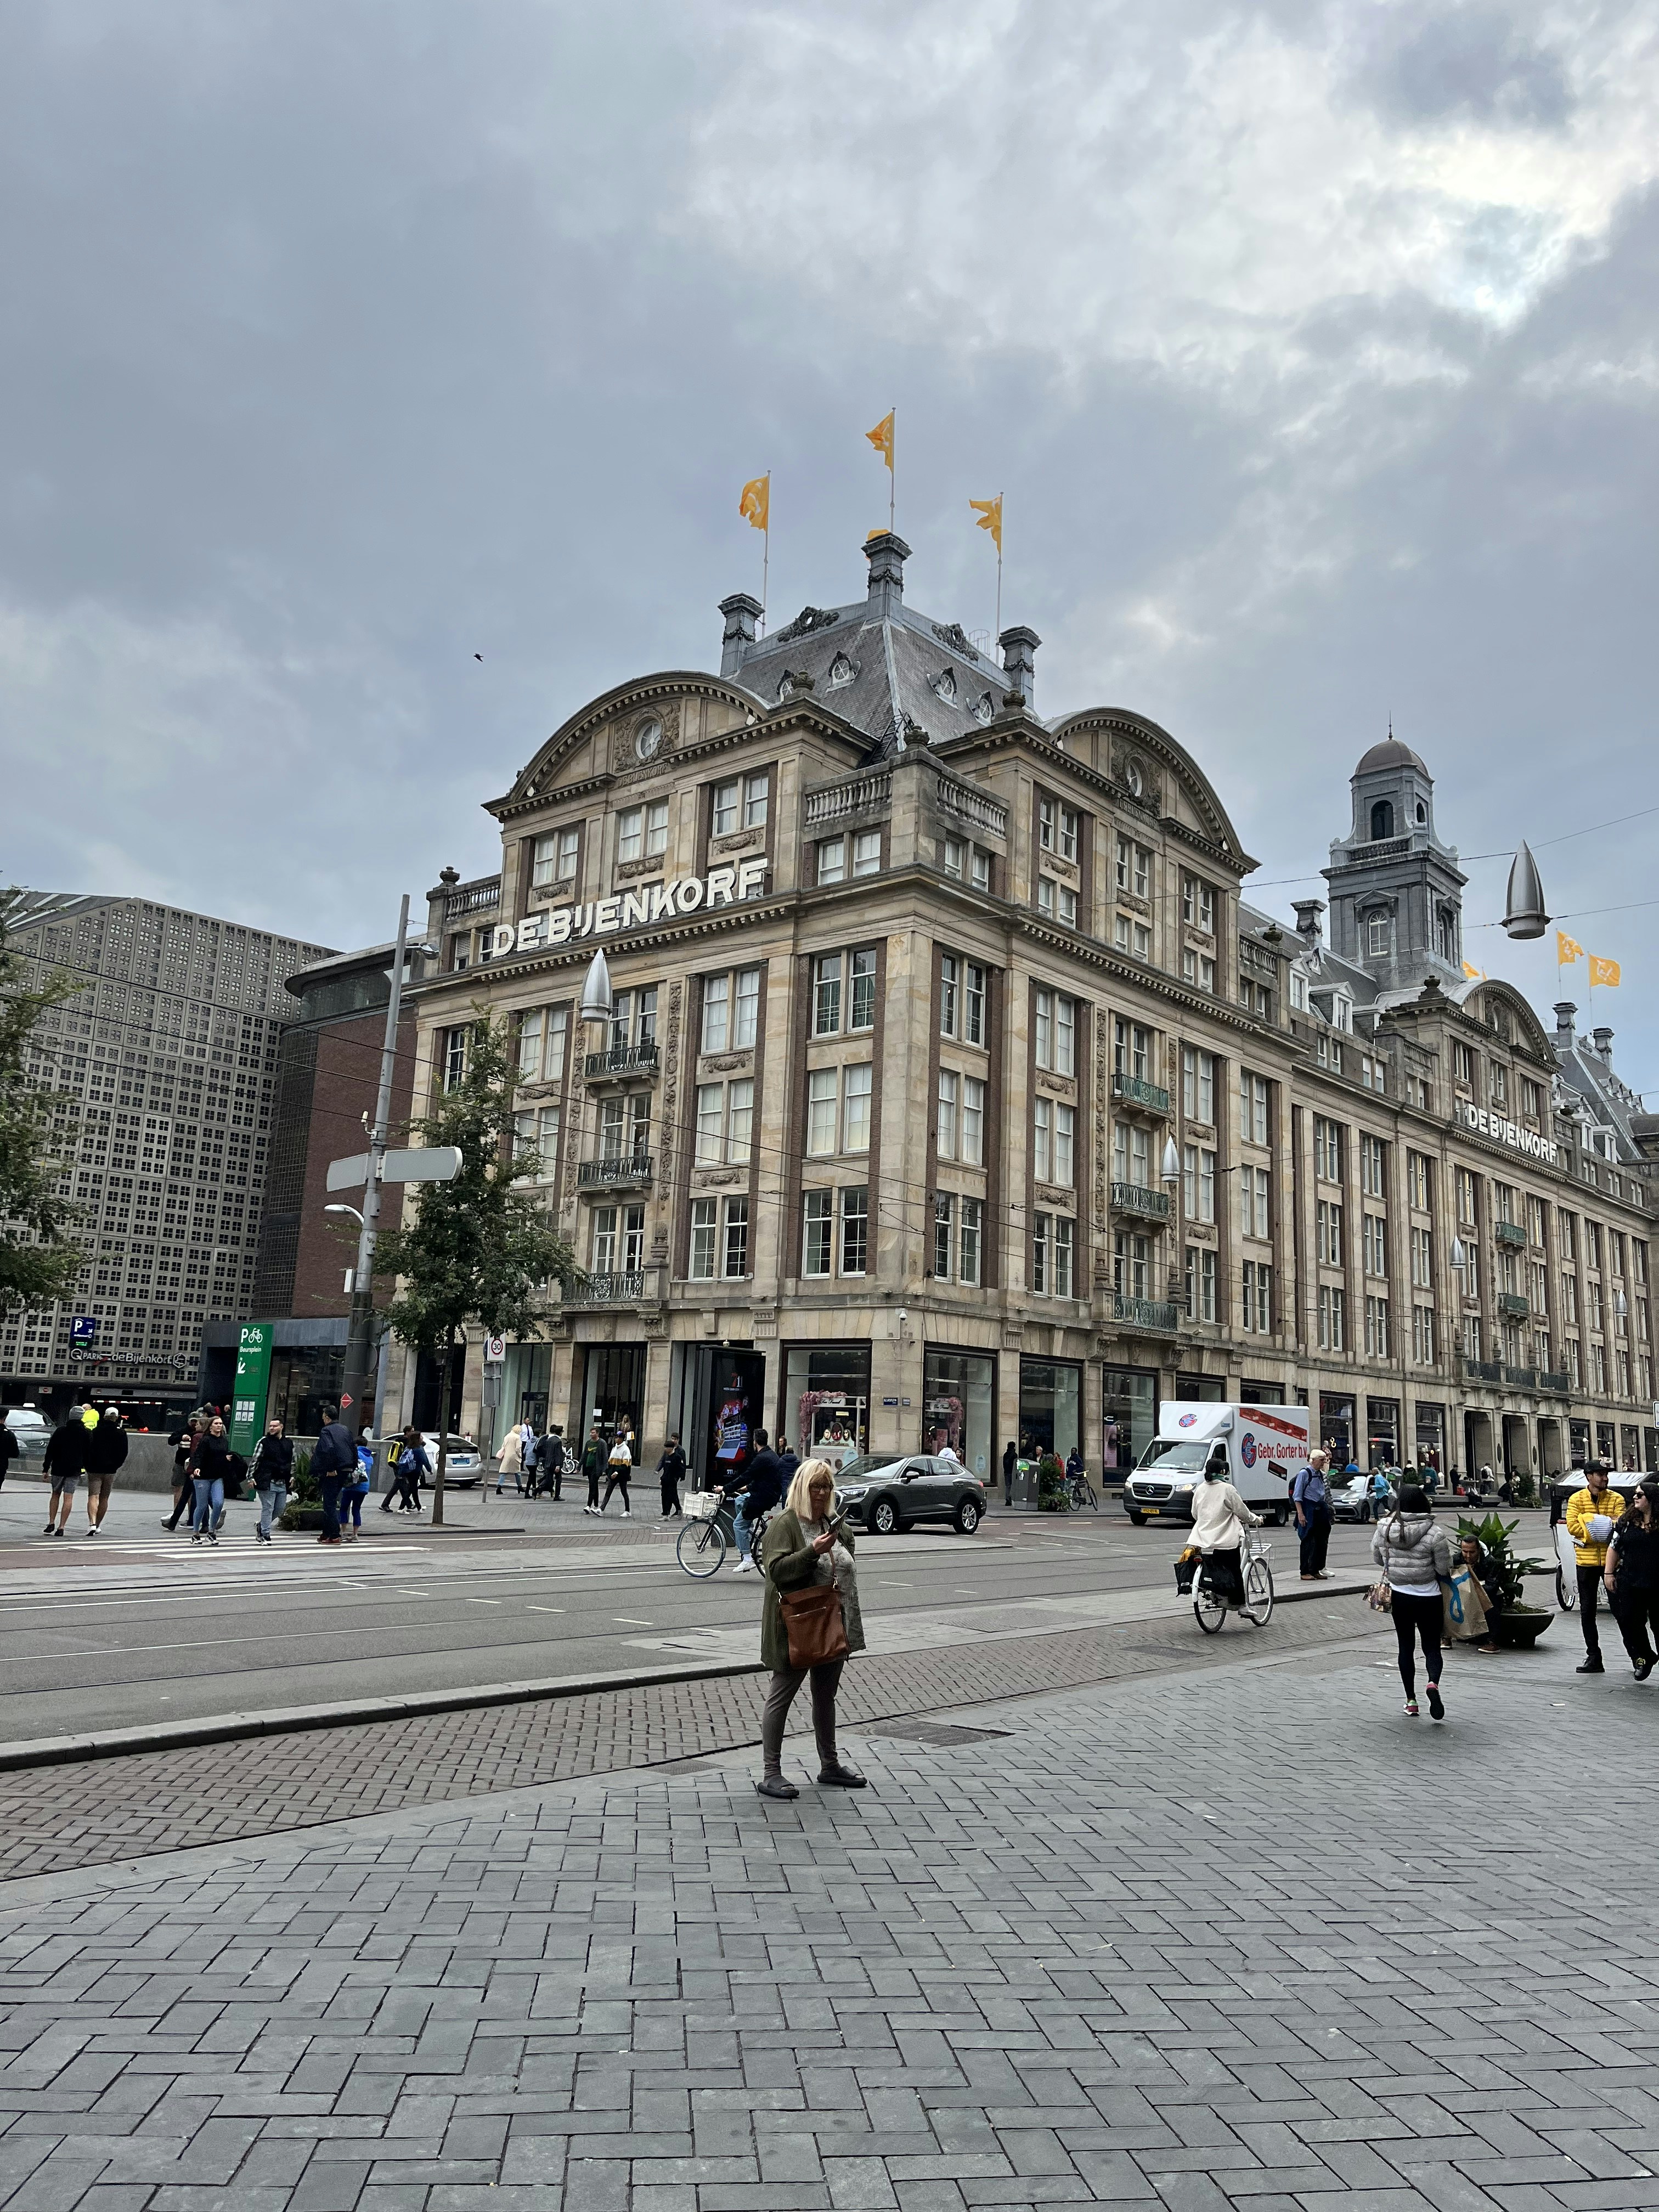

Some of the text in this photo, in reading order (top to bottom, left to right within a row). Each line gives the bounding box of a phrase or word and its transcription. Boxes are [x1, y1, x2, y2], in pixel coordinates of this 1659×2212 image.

[493, 858, 769, 957] DE BIJENKORF
[1468, 1103, 1558, 1163] DE BIJENKORF
[74, 1320, 83, 1332] P
[240, 1328, 249, 1343] P
[1257, 1442, 1276, 1459] Gebr.
[1277, 1442, 1297, 1459] Gorter
